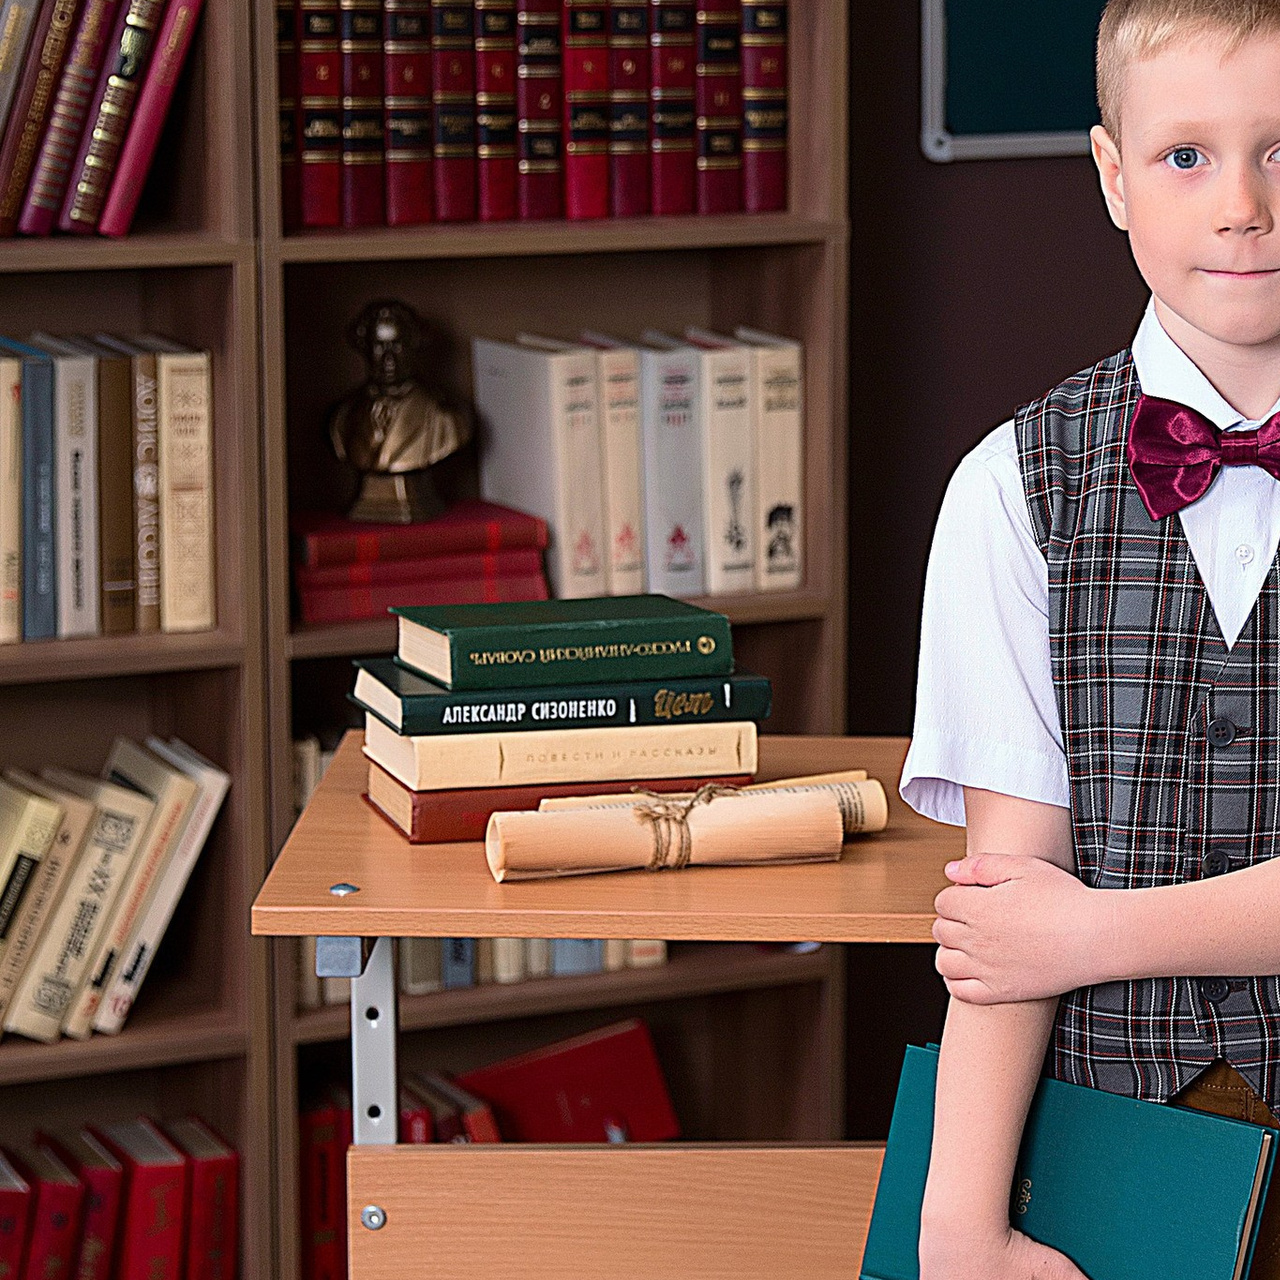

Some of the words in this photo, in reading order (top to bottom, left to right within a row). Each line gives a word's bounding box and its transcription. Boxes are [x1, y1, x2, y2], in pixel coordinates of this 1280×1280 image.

[469, 649, 536, 666] СЛОВАРЬ
[540, 640, 691, 663] РУССКО-АНГЛИЙСКИЙ
[442, 702, 527, 725] АЛЕКСАНДР
[531, 698, 617, 720] СИЗОНЕНКО
[526, 752, 604, 763] ПОВЕСТИ
[612, 751, 621, 759] И
[630, 746, 718, 758] РАССКАЗЫ
